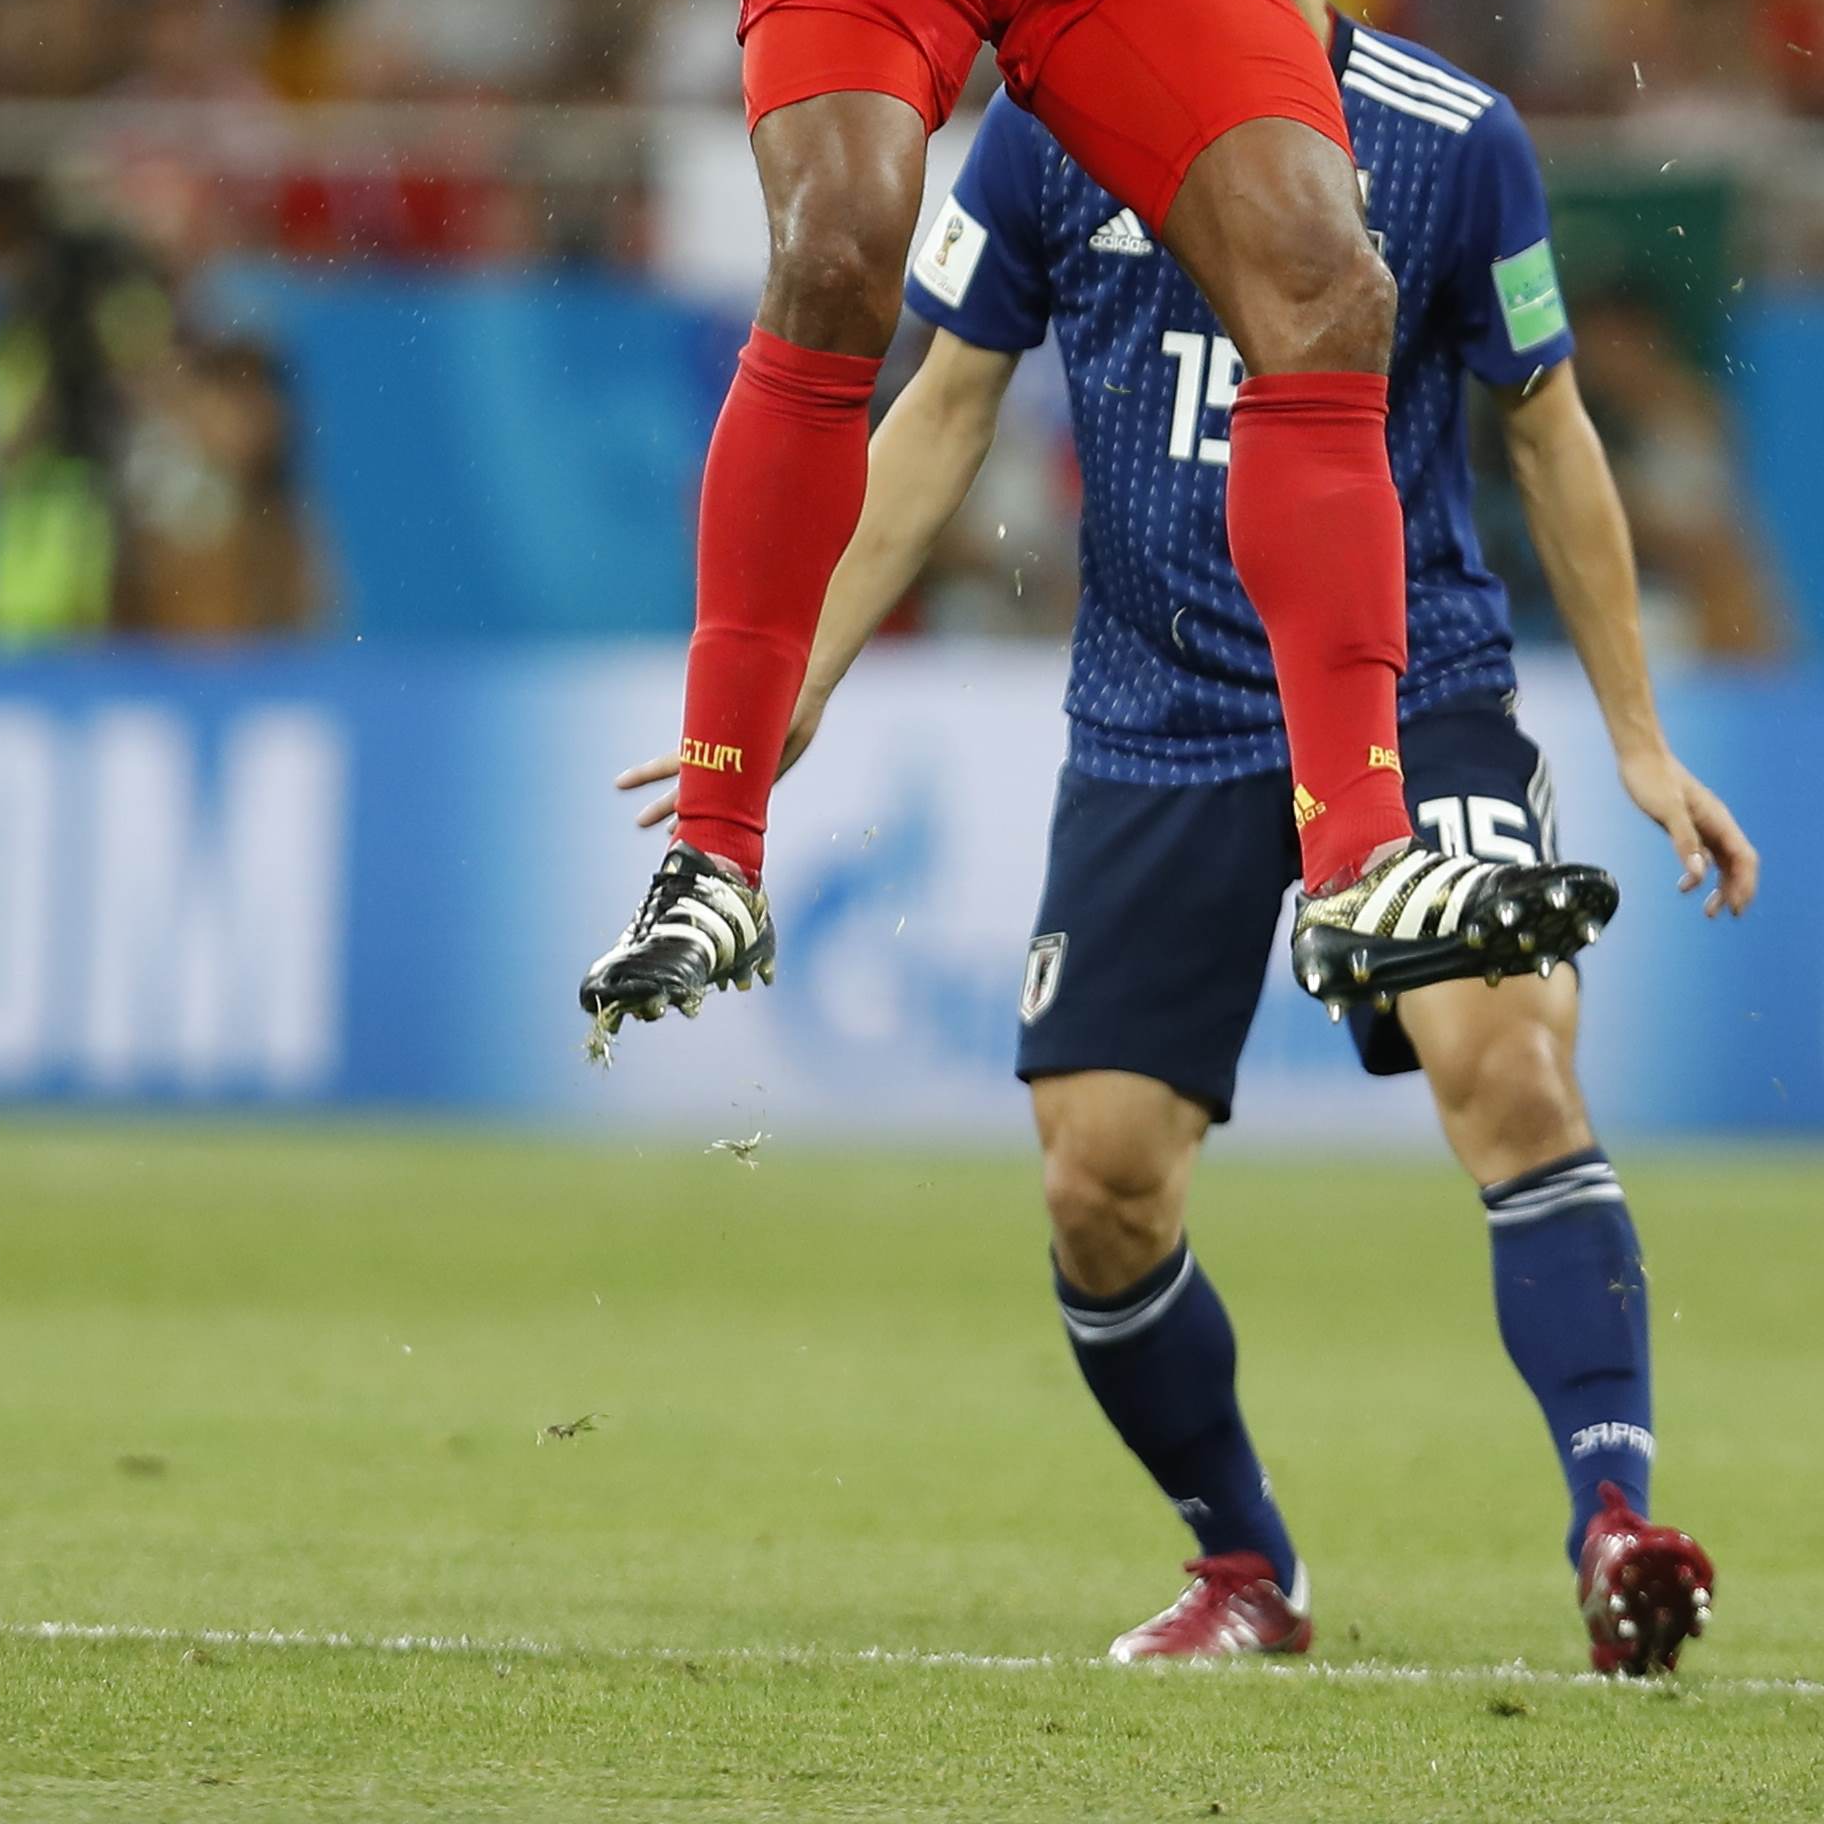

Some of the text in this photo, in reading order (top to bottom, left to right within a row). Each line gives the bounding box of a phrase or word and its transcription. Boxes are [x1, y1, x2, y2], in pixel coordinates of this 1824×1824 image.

[1089, 235, 1154, 255] adidas
[1417, 794, 1537, 869] 15
[1570, 1421, 1656, 1460] JAPAN
